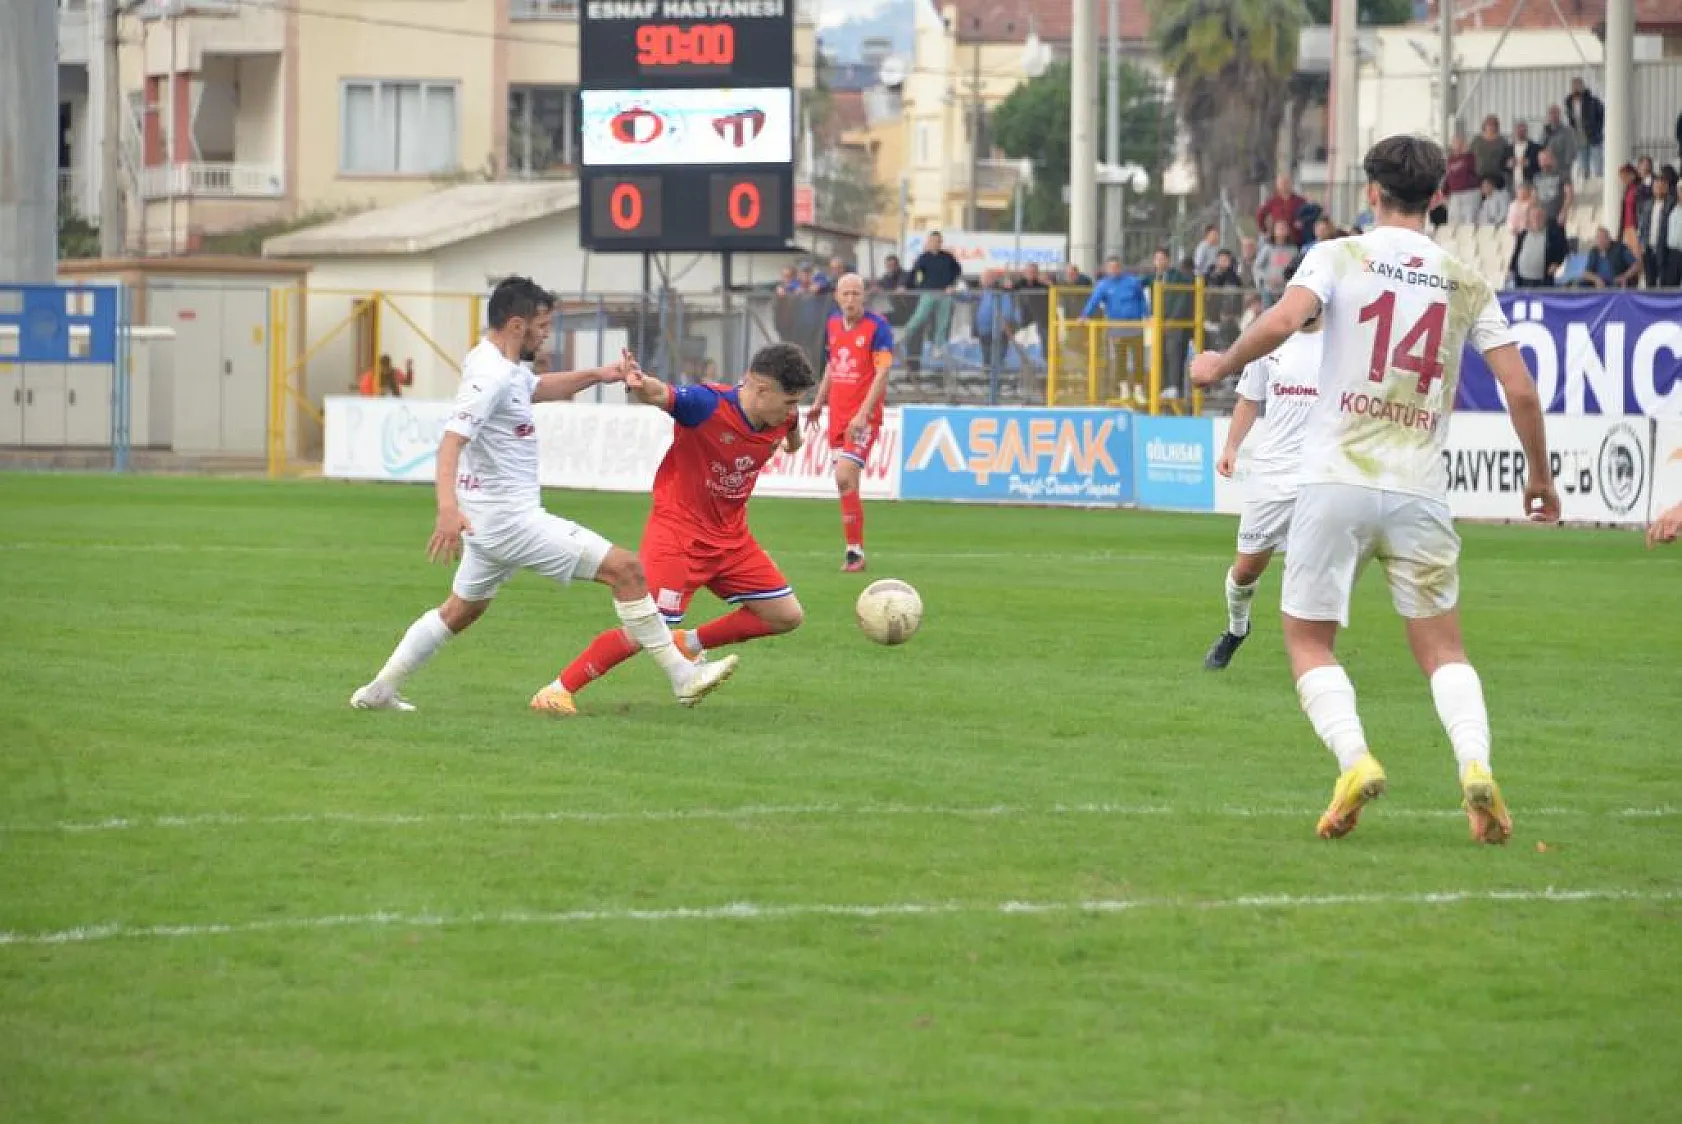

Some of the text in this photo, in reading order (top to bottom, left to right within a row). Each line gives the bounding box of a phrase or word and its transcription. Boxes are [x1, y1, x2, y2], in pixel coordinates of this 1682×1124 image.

[588, 1, 656, 18] ESNAF
[636, 24, 734, 65] 90:00
[610, 183, 643, 232] 0
[728, 182, 760, 229] 0
[1358, 289, 1447, 394] 14
[1340, 392, 1438, 431] KOCATÜRK
[968, 418, 1118, 486] ŞAFAK
